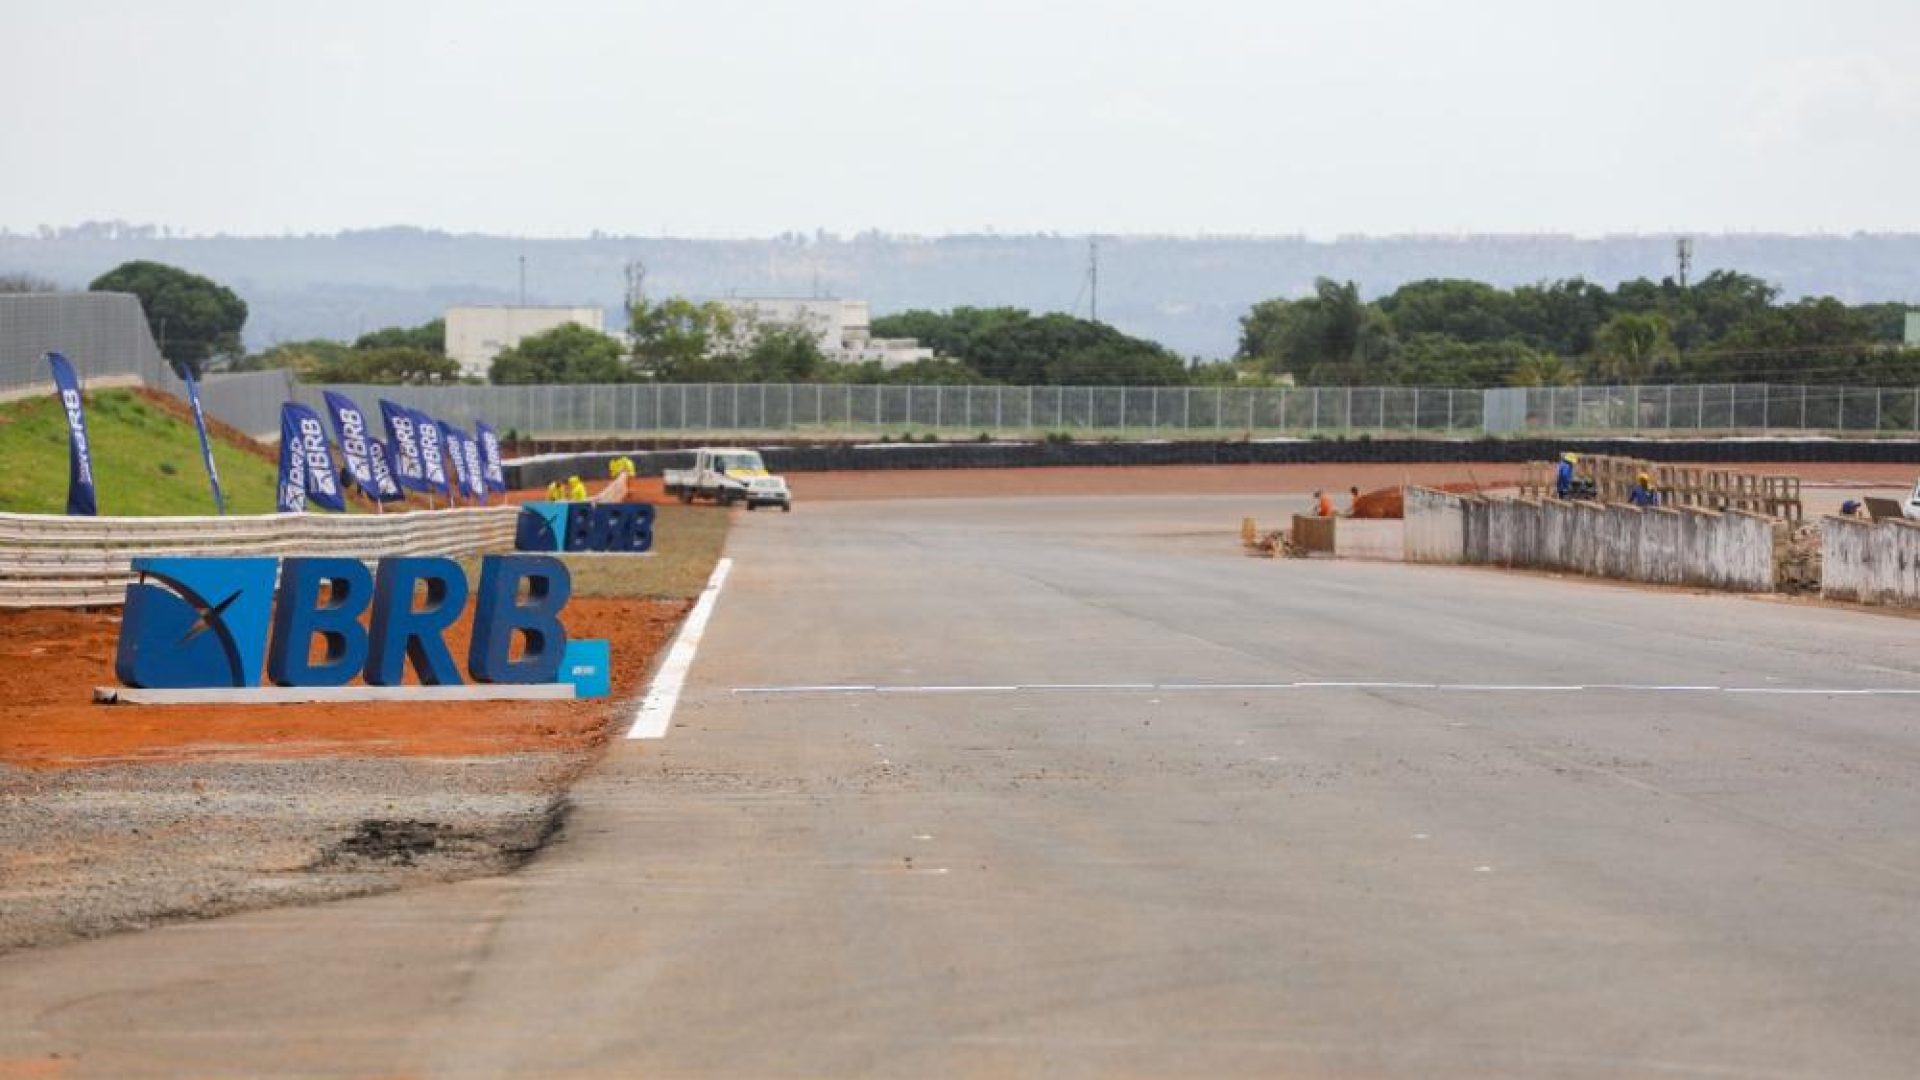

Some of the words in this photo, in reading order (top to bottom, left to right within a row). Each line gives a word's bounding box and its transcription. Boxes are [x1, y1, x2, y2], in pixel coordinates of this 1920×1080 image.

[301, 418, 328, 468] BRB
[339, 408, 367, 456] BRB
[419, 423, 440, 464] BRB
[567, 503, 655, 552] BRB
[267, 555, 571, 686] BRB
